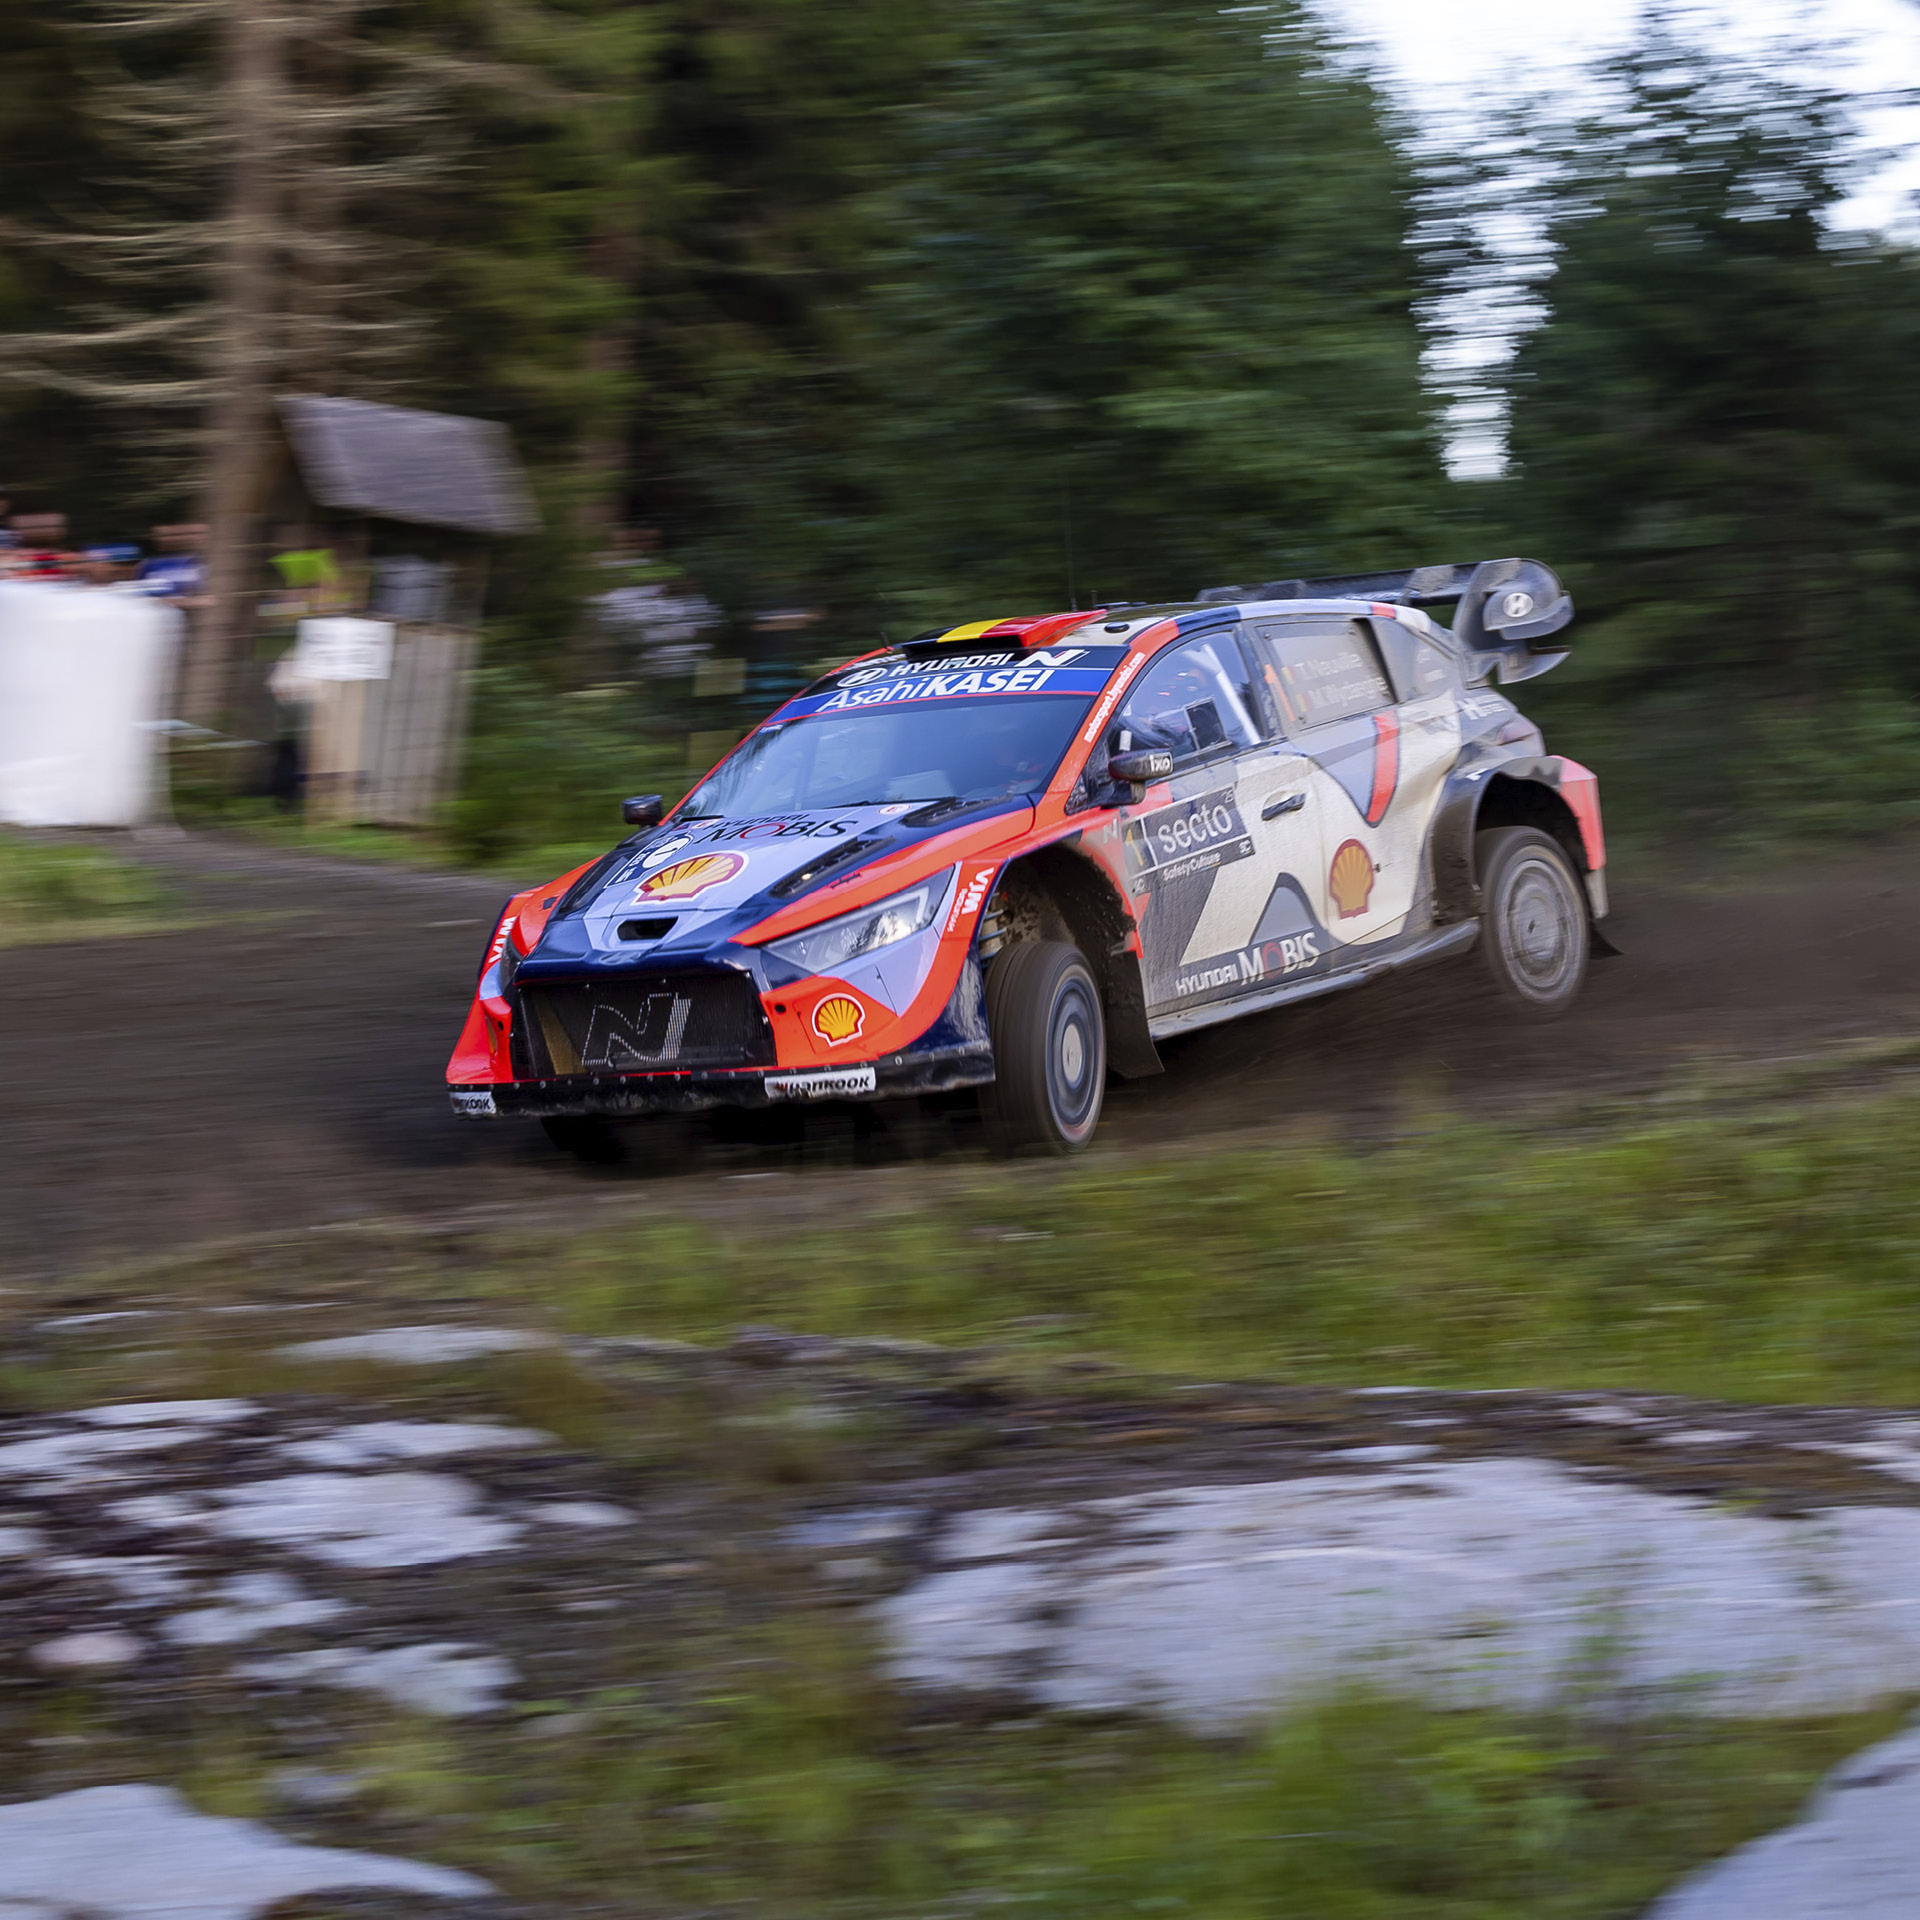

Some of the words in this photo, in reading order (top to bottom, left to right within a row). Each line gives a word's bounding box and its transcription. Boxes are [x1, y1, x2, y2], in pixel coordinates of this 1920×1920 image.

[888, 652, 1014, 678] HYUNDAI
[814, 669, 1056, 713] AsahiKASEI
[692, 820, 859, 845] MOBIS
[702, 813, 811, 831] HYUNDAI
[1157, 803, 1233, 854] secto
[1174, 963, 1239, 997] HYUNDAI
[1236, 931, 1321, 986] MOBIS
